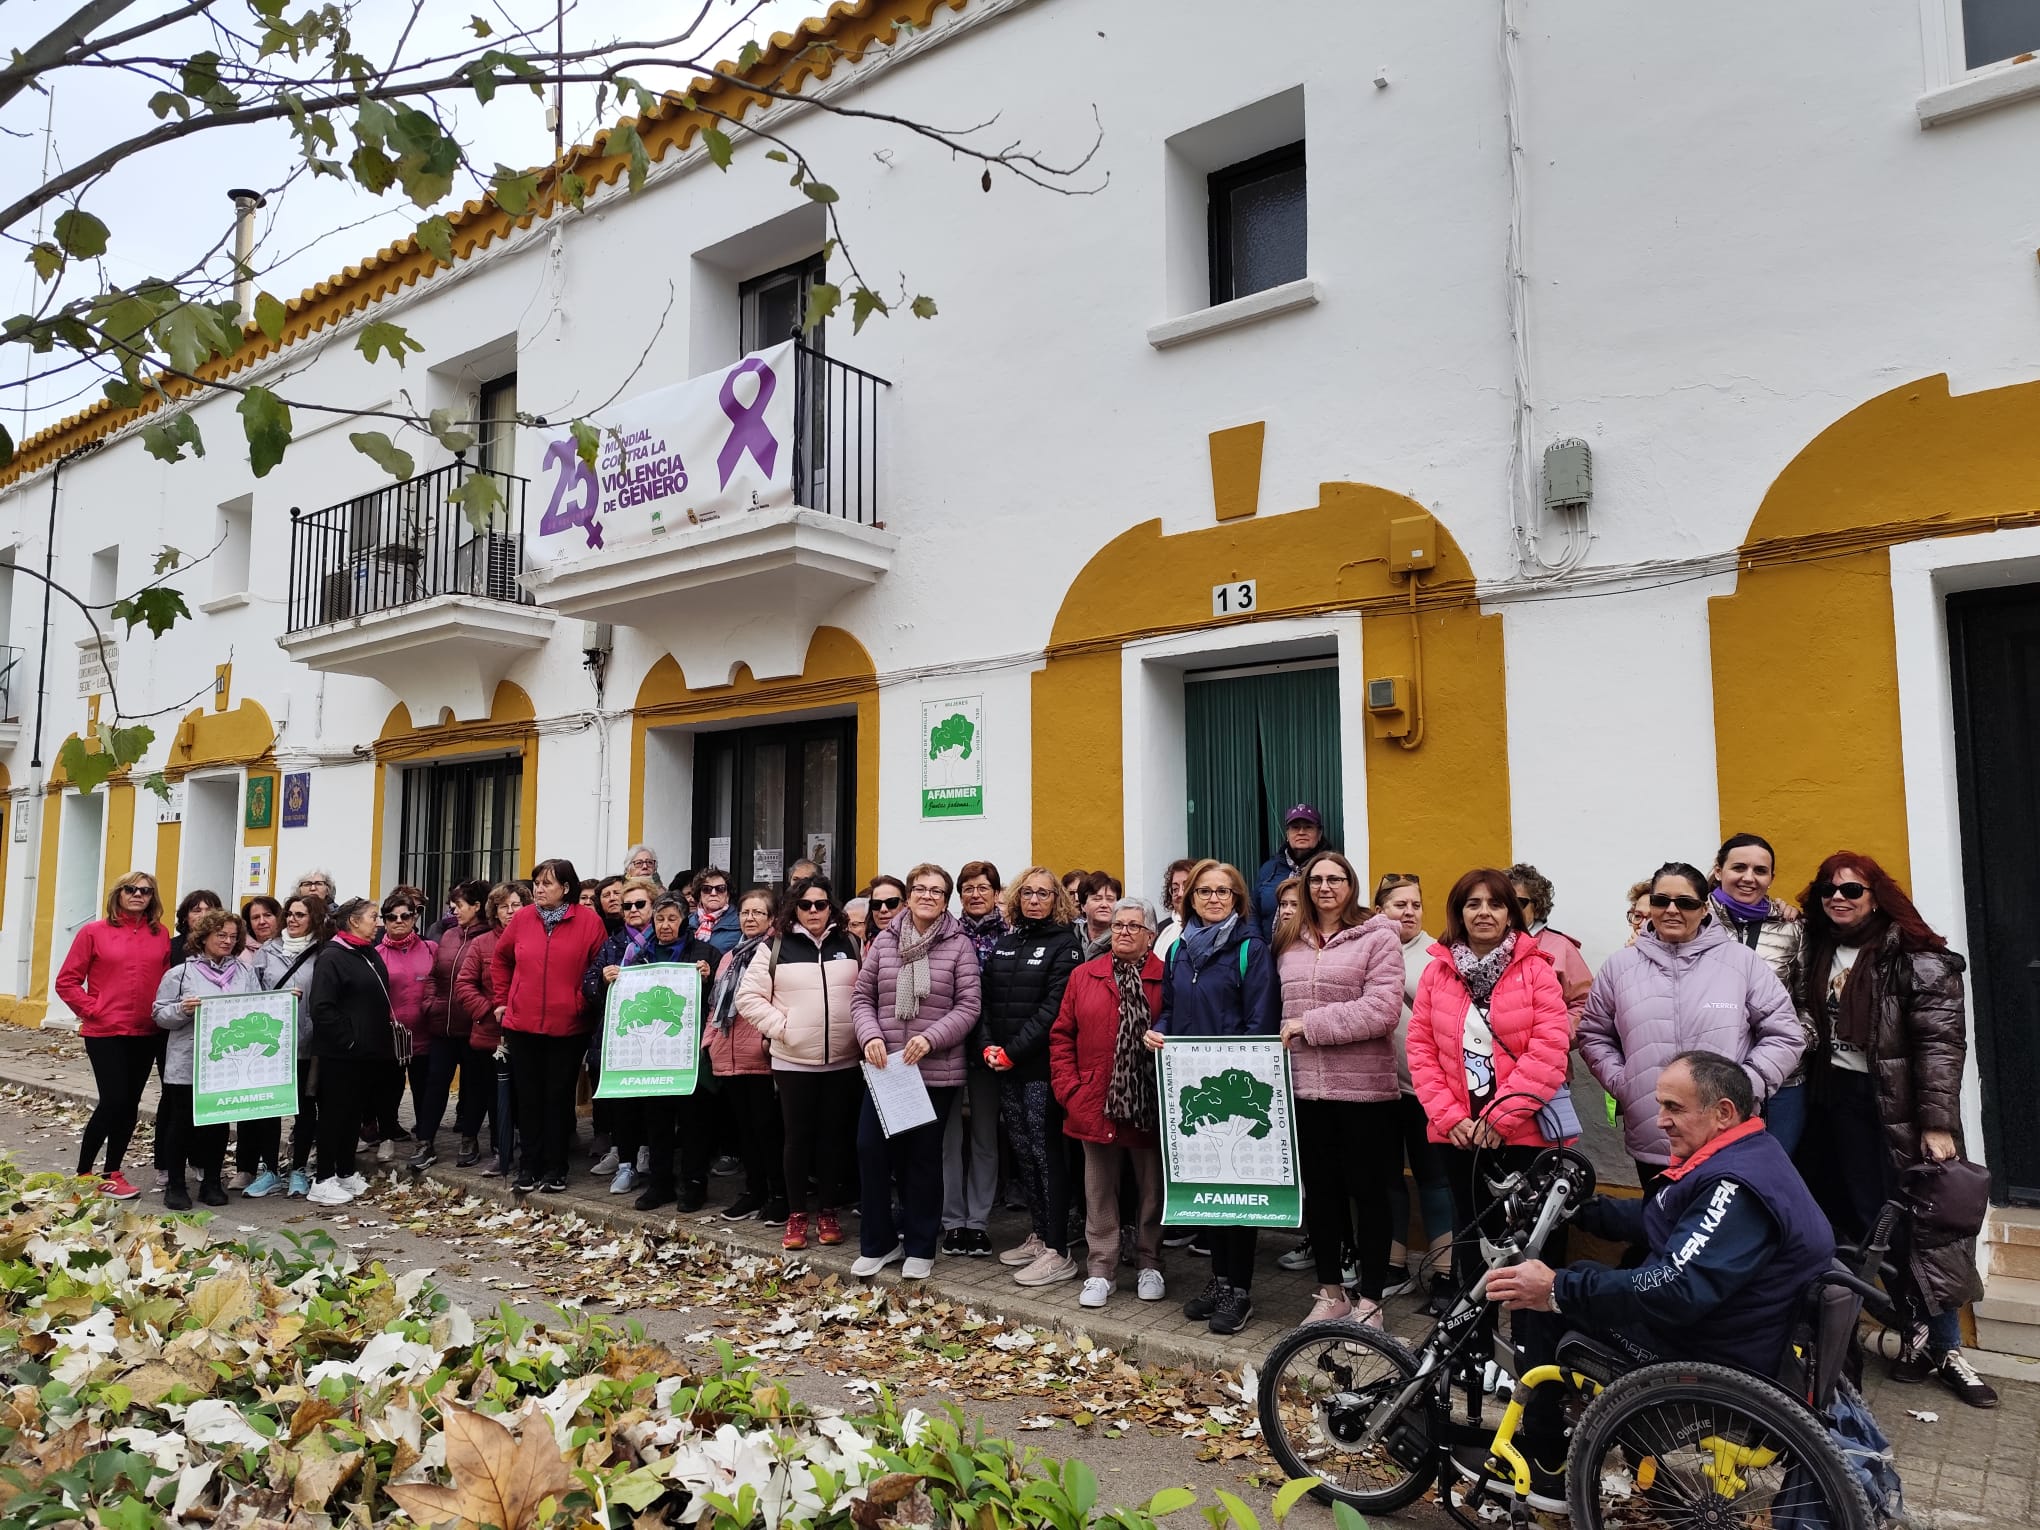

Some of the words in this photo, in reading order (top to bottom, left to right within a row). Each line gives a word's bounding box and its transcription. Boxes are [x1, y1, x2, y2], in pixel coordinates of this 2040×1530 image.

[651, 440, 666, 456] LA
[602, 454, 684, 494] VIOLENCIA
[540, 436, 600, 536] 25
[604, 500, 616, 514] DE
[1218, 584, 1252, 612] 13
[928, 788, 976, 800] AFAMMER
[620, 1076, 674, 1086] AFAMMER
[1165, 1054, 1174, 1098] FAMILIAS
[216, 1092, 274, 1106] AFAMMER
[1170, 1101, 1176, 1114] DE
[1276, 1089, 1286, 1128] MEDIO
[1280, 1139, 1292, 1182] RURAL
[1193, 1193, 1270, 1206] AFAMMER
[1700, 1180, 1740, 1233] KAPPA
[1446, 1308, 1476, 1330] BATEC
[1586, 1376, 1679, 1441] SCHWALBE
[1676, 1419, 1712, 1440] QUICKIE
